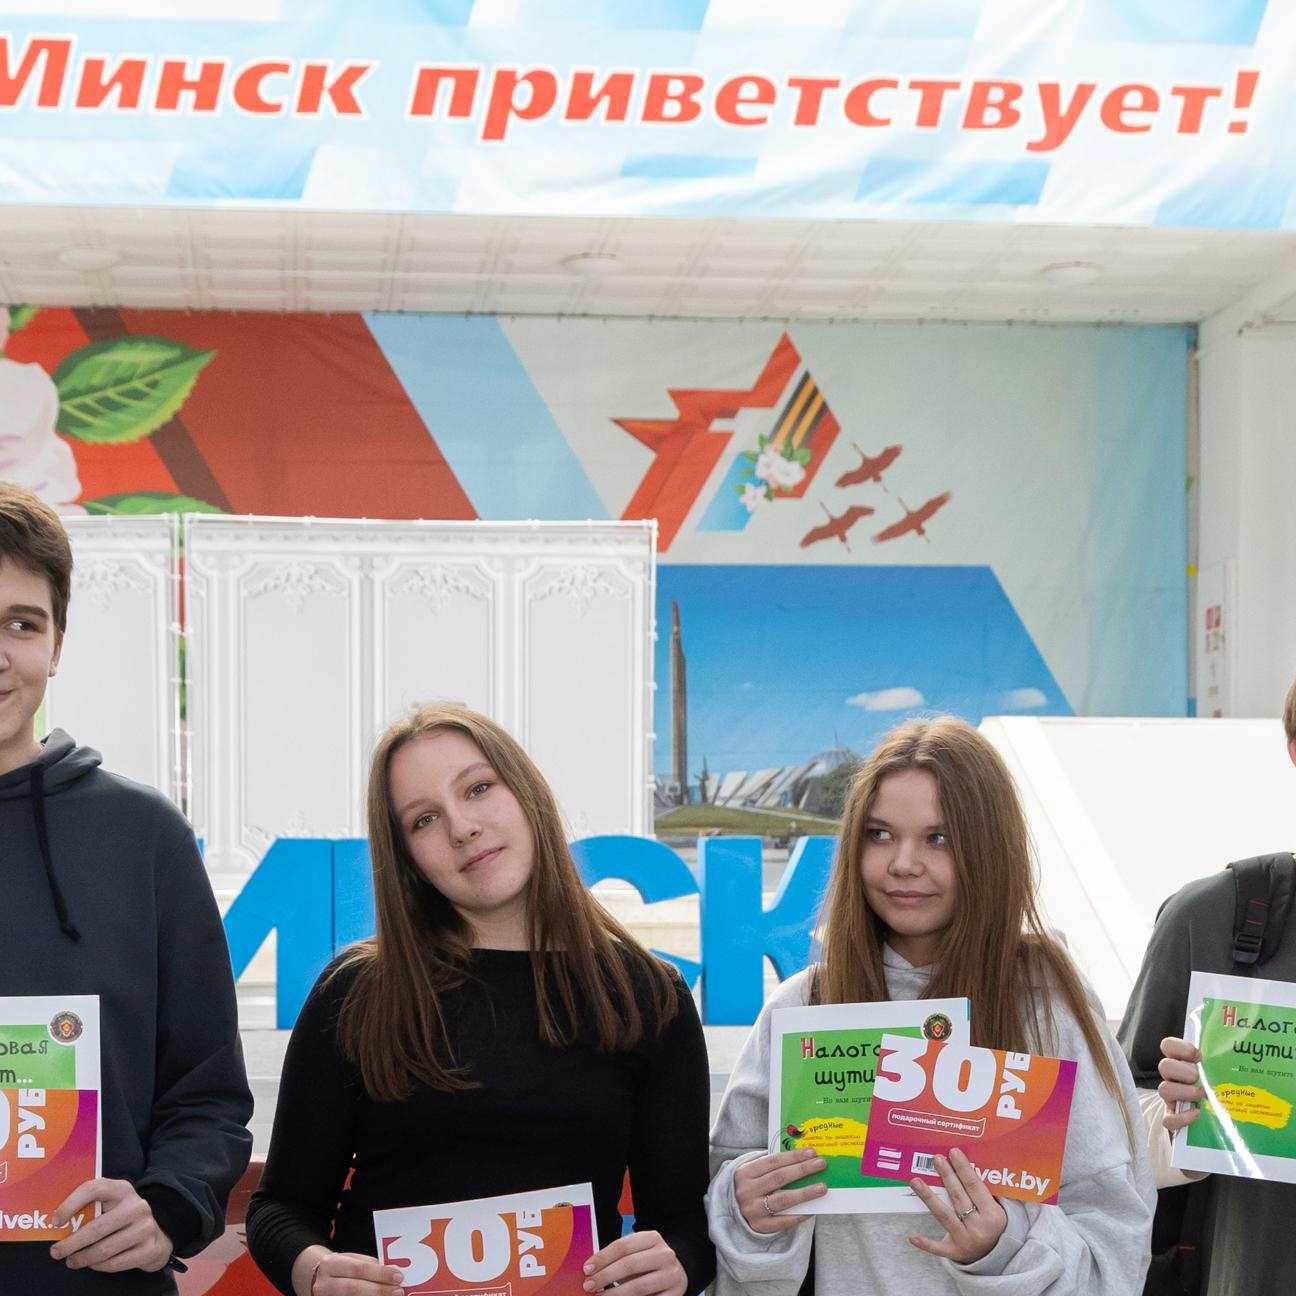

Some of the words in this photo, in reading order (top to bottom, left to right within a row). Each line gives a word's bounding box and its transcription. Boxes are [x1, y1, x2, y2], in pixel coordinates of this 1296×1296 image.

[409, 65, 1260, 153] приветствует!
[873, 1034, 997, 1112] 30
[891, 1112, 937, 1127] подарочный
[936, 1118, 980, 1134] сертификат
[382, 1209, 511, 1288] 30
